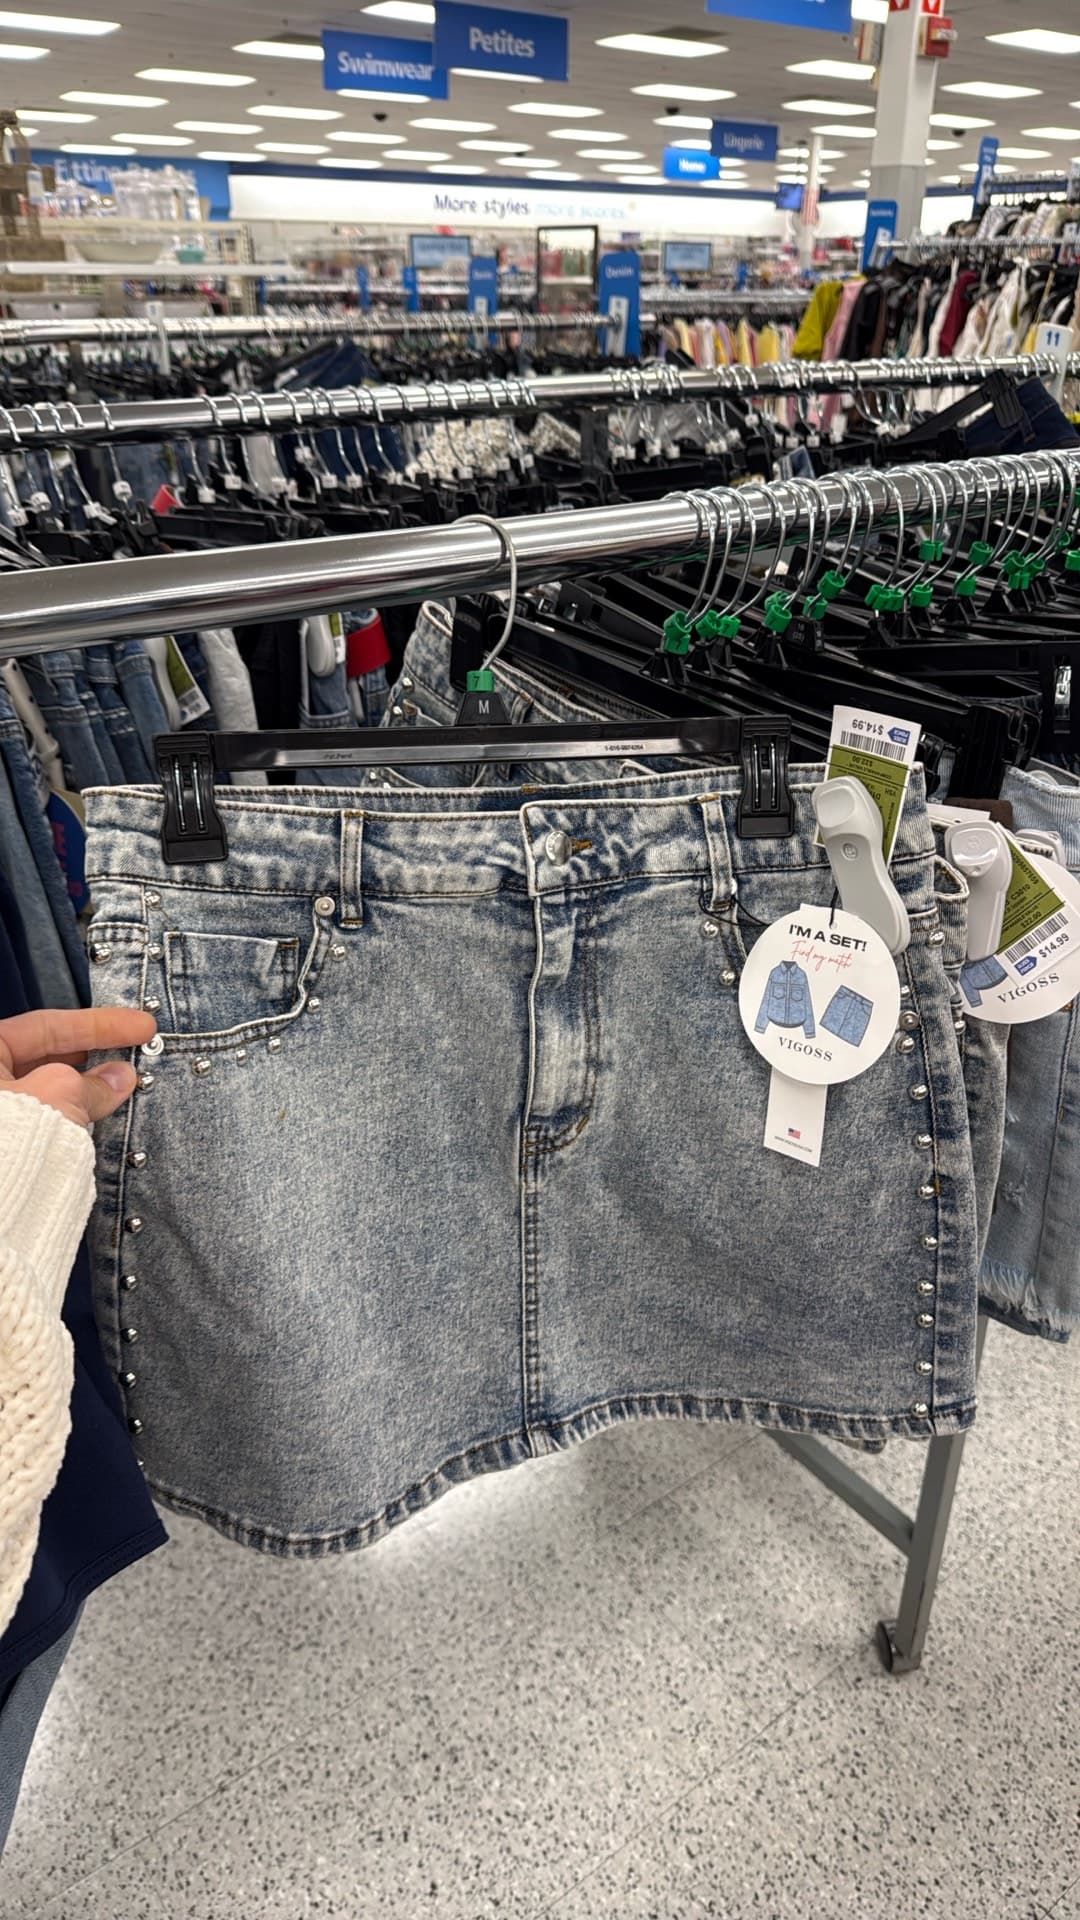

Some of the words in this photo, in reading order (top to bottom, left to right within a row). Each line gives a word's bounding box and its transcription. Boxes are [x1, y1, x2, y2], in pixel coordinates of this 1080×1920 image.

[468, 26, 536, 58] Petites
[338, 51, 433, 81] Swimwear
[723, 132, 764, 153] Lingerie
[435, 194, 477, 211] More
[484, 198, 530, 218] styles
[1046, 330, 1060, 347] 11
[472, 675, 481, 689] 7
[478, 699, 490, 715] M
[852, 719, 884, 735] $14.99
[789, 924, 812, 939] I'M
[814, 930, 826, 943] A
[829, 933, 868, 952] SET!
[1038, 933, 1070, 958] $14.99
[789, 940, 815, 962] Find
[812, 952, 827, 972] my
[997, 972, 1060, 1003] VIGOSS
[778, 1036, 833, 1062] VIGOSS
